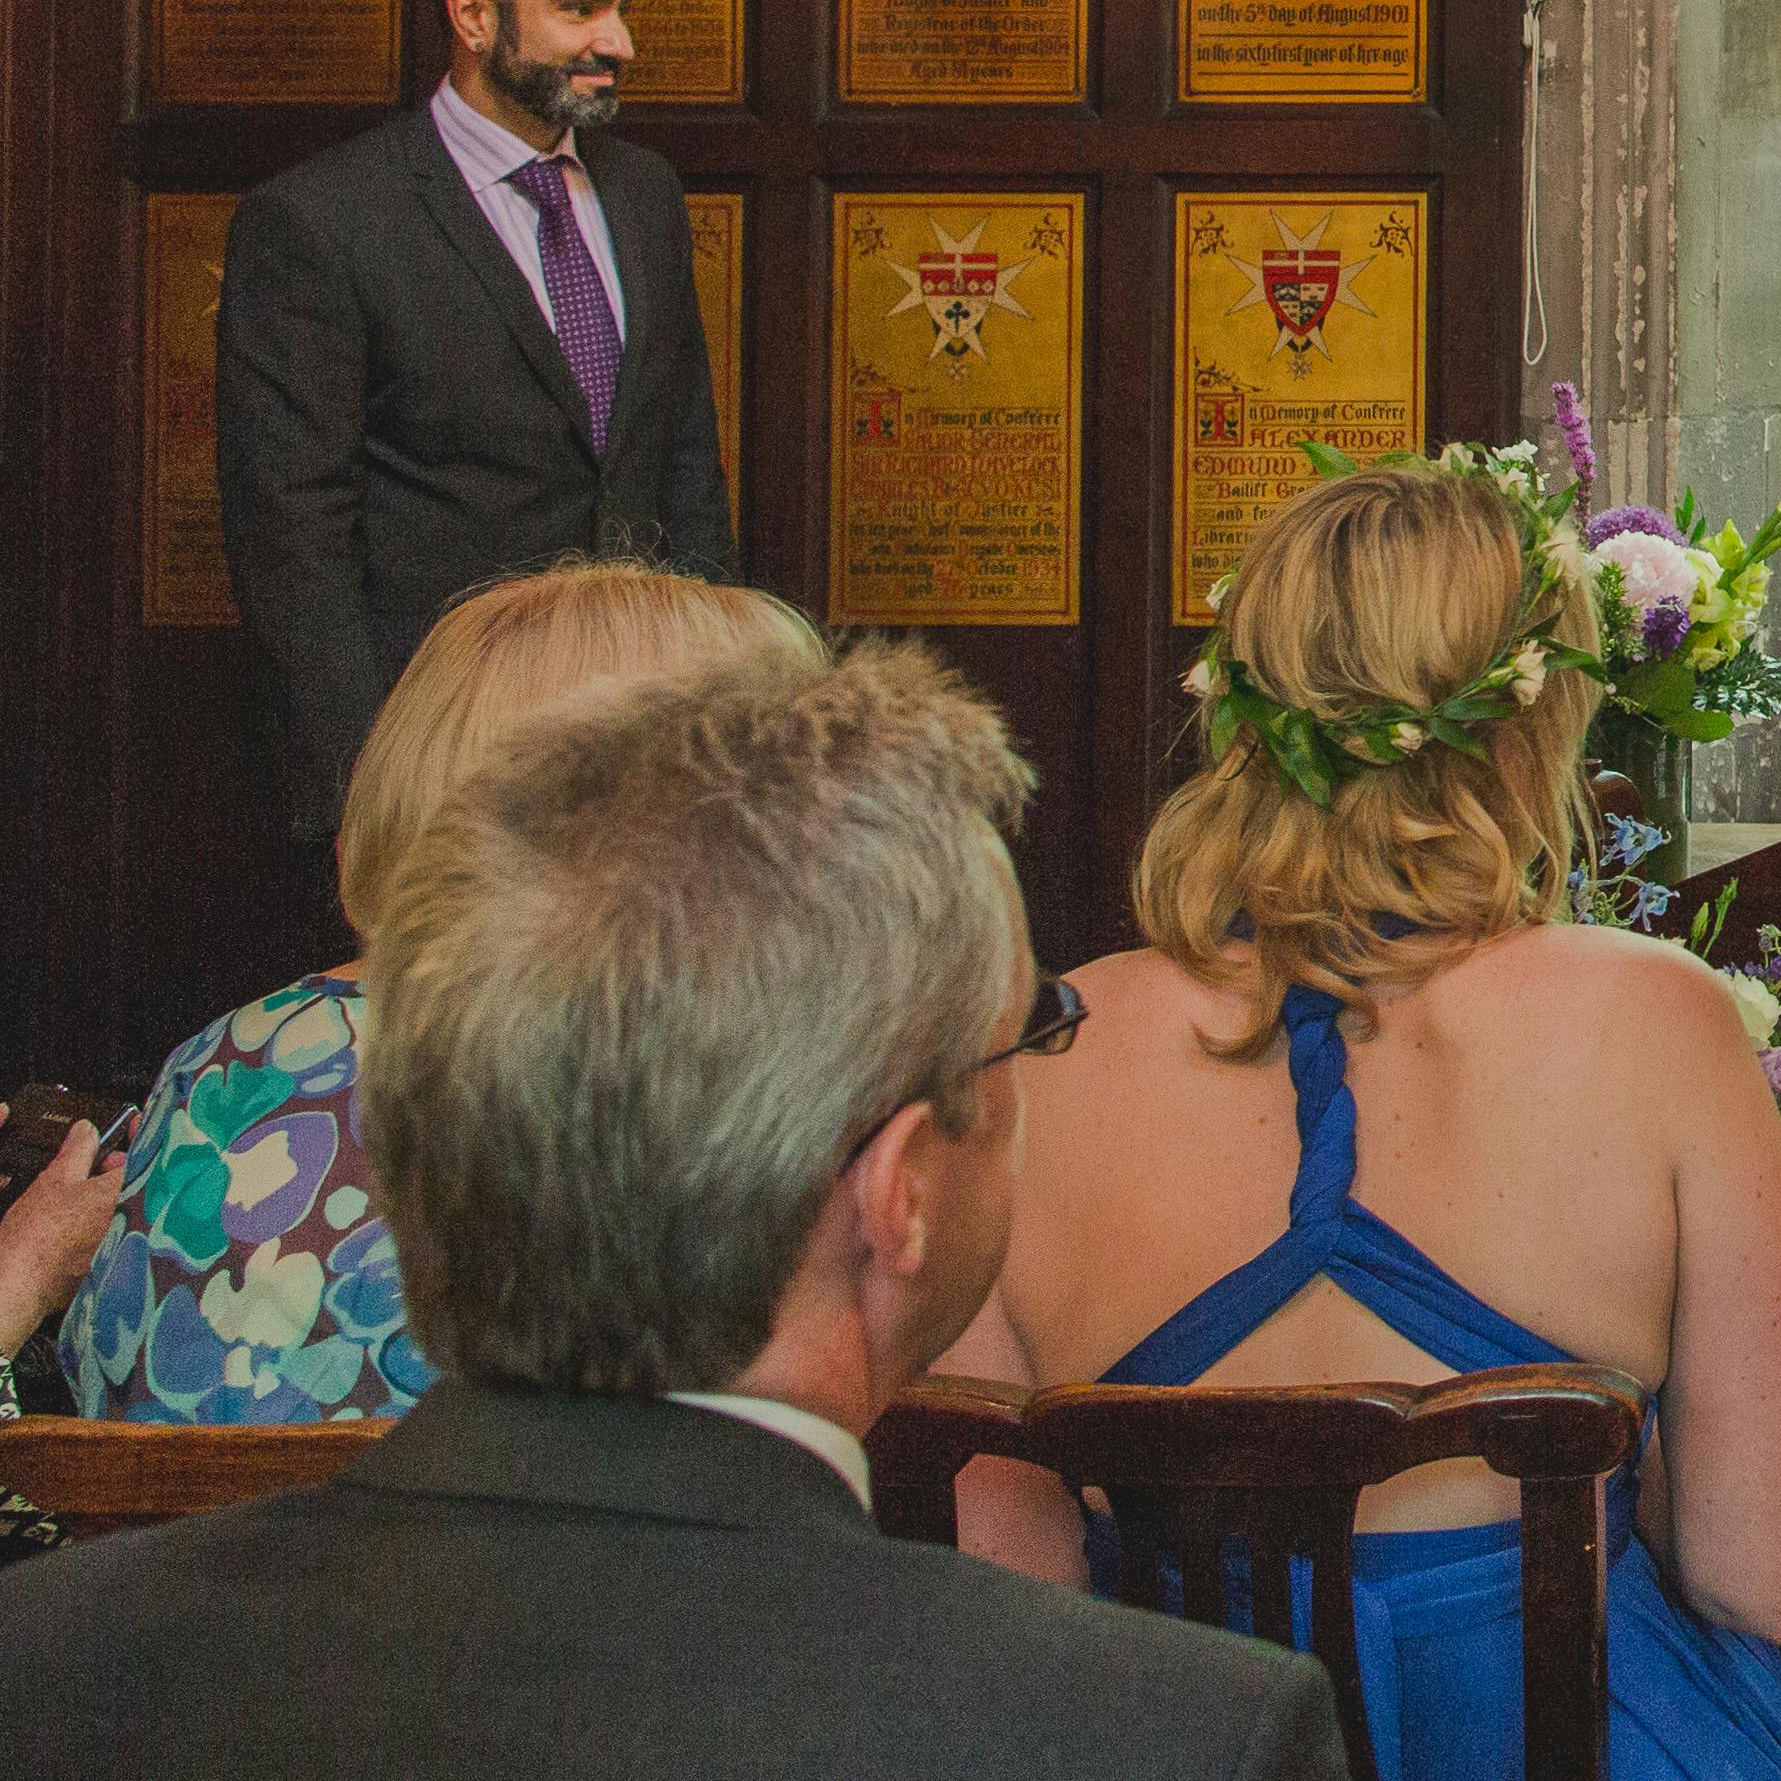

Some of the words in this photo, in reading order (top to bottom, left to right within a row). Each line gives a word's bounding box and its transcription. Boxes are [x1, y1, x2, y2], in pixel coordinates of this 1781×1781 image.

[1259, 404, 1319, 424] Memory
[1322, 403, 1337, 420] of
[1193, 455, 1297, 477] EDMUND
